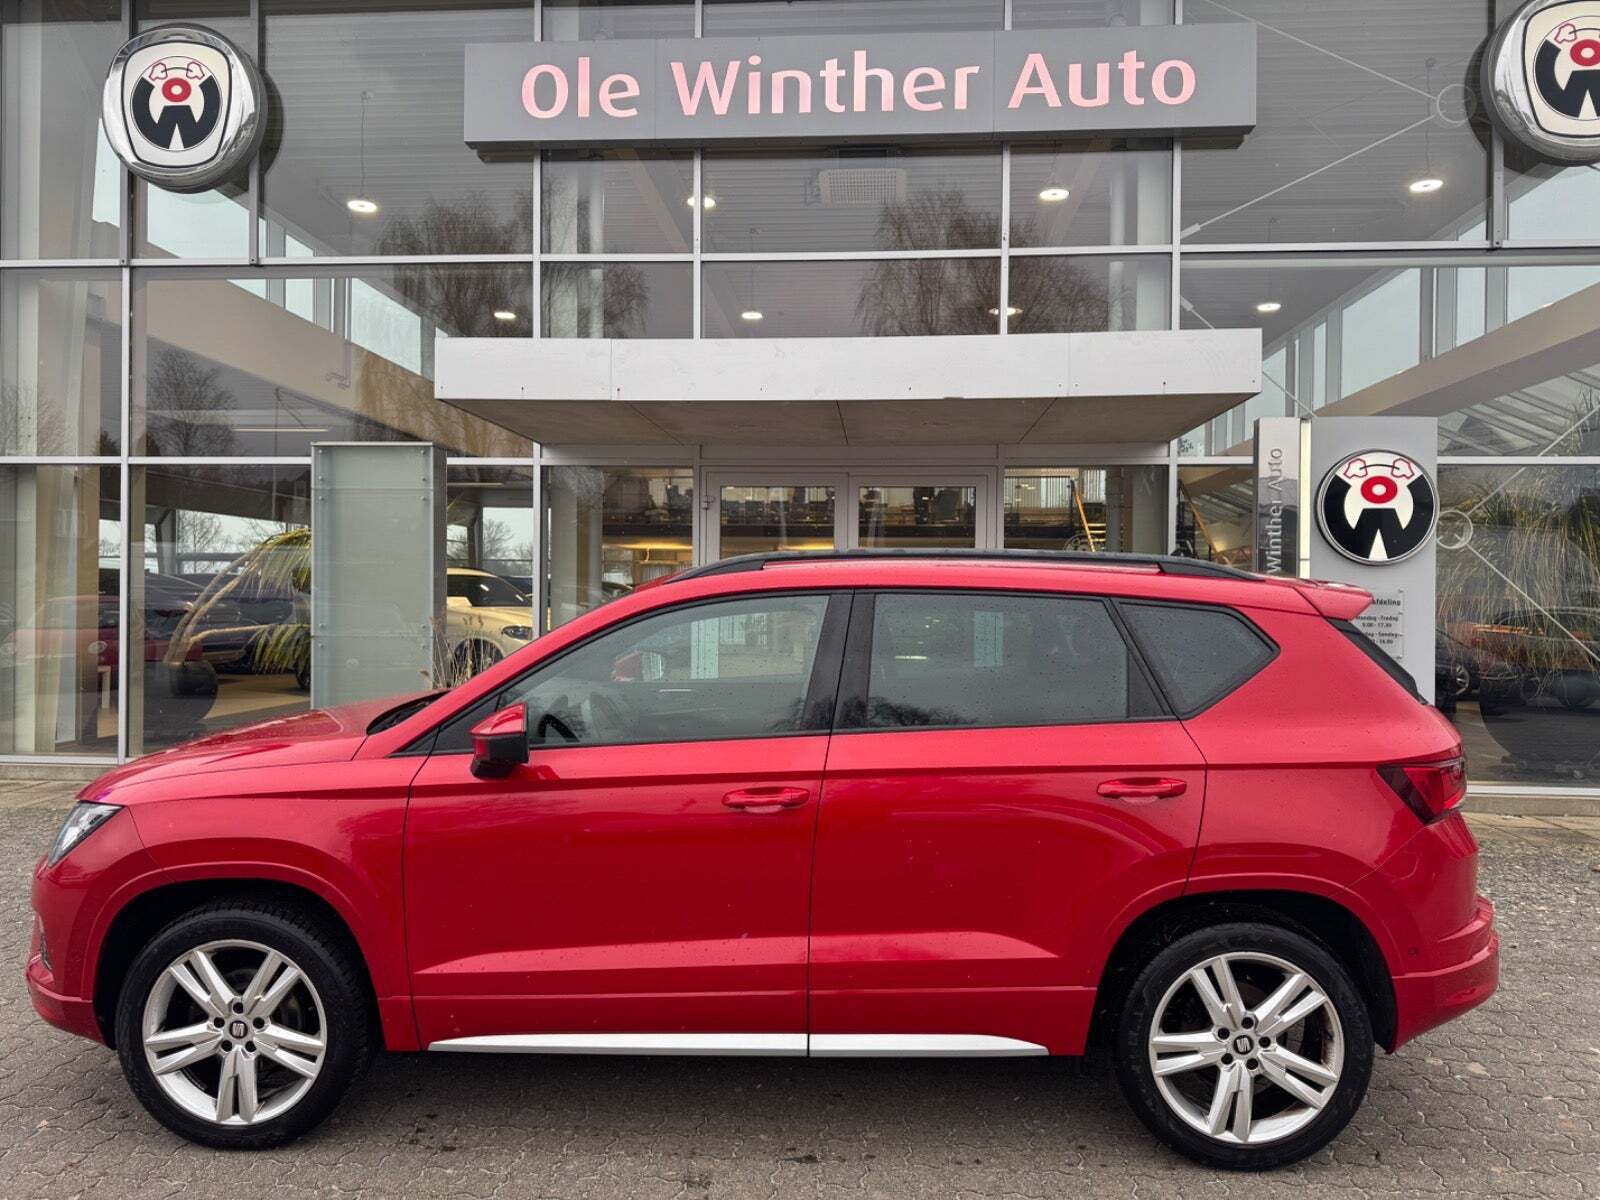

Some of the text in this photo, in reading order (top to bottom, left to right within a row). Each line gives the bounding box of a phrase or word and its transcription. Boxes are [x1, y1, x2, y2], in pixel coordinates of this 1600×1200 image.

[521, 50, 1196, 119] Ole Winther Auto
[1265, 448, 1282, 574] Winther Auto
